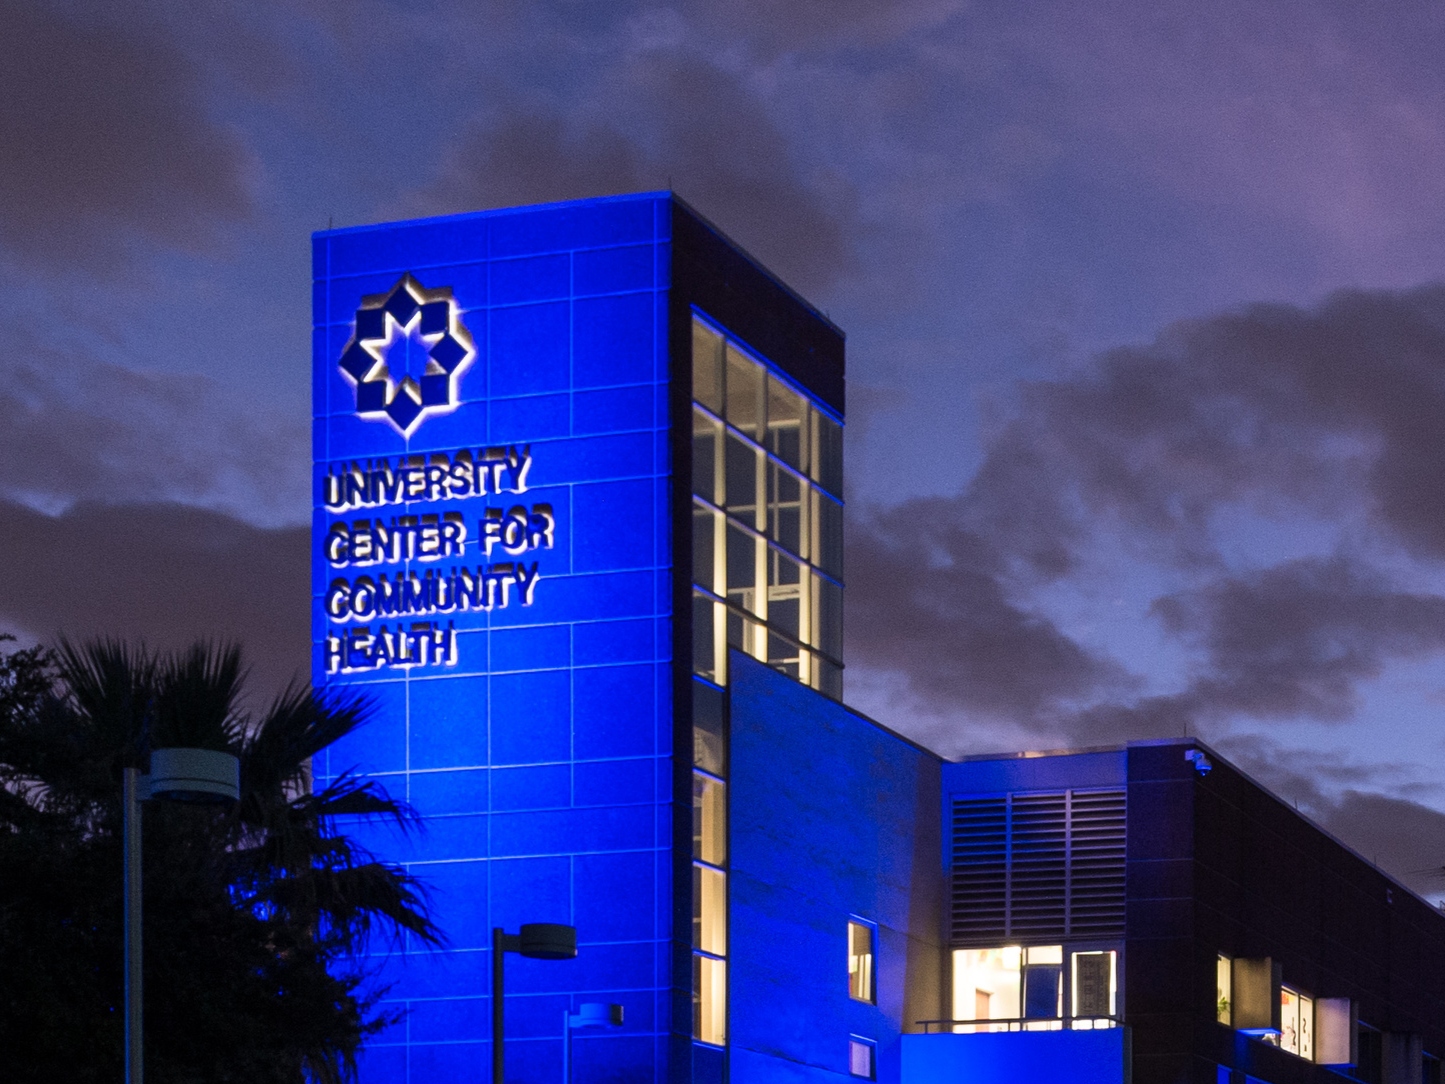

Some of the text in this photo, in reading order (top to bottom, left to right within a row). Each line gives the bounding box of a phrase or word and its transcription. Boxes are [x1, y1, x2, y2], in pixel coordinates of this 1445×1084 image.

[323, 446, 532, 513] UNIVERSITY
[324, 503, 555, 569] CENTER FOR
[324, 562, 540, 624] COMMUNITY
[324, 621, 458, 675] HEALTH
